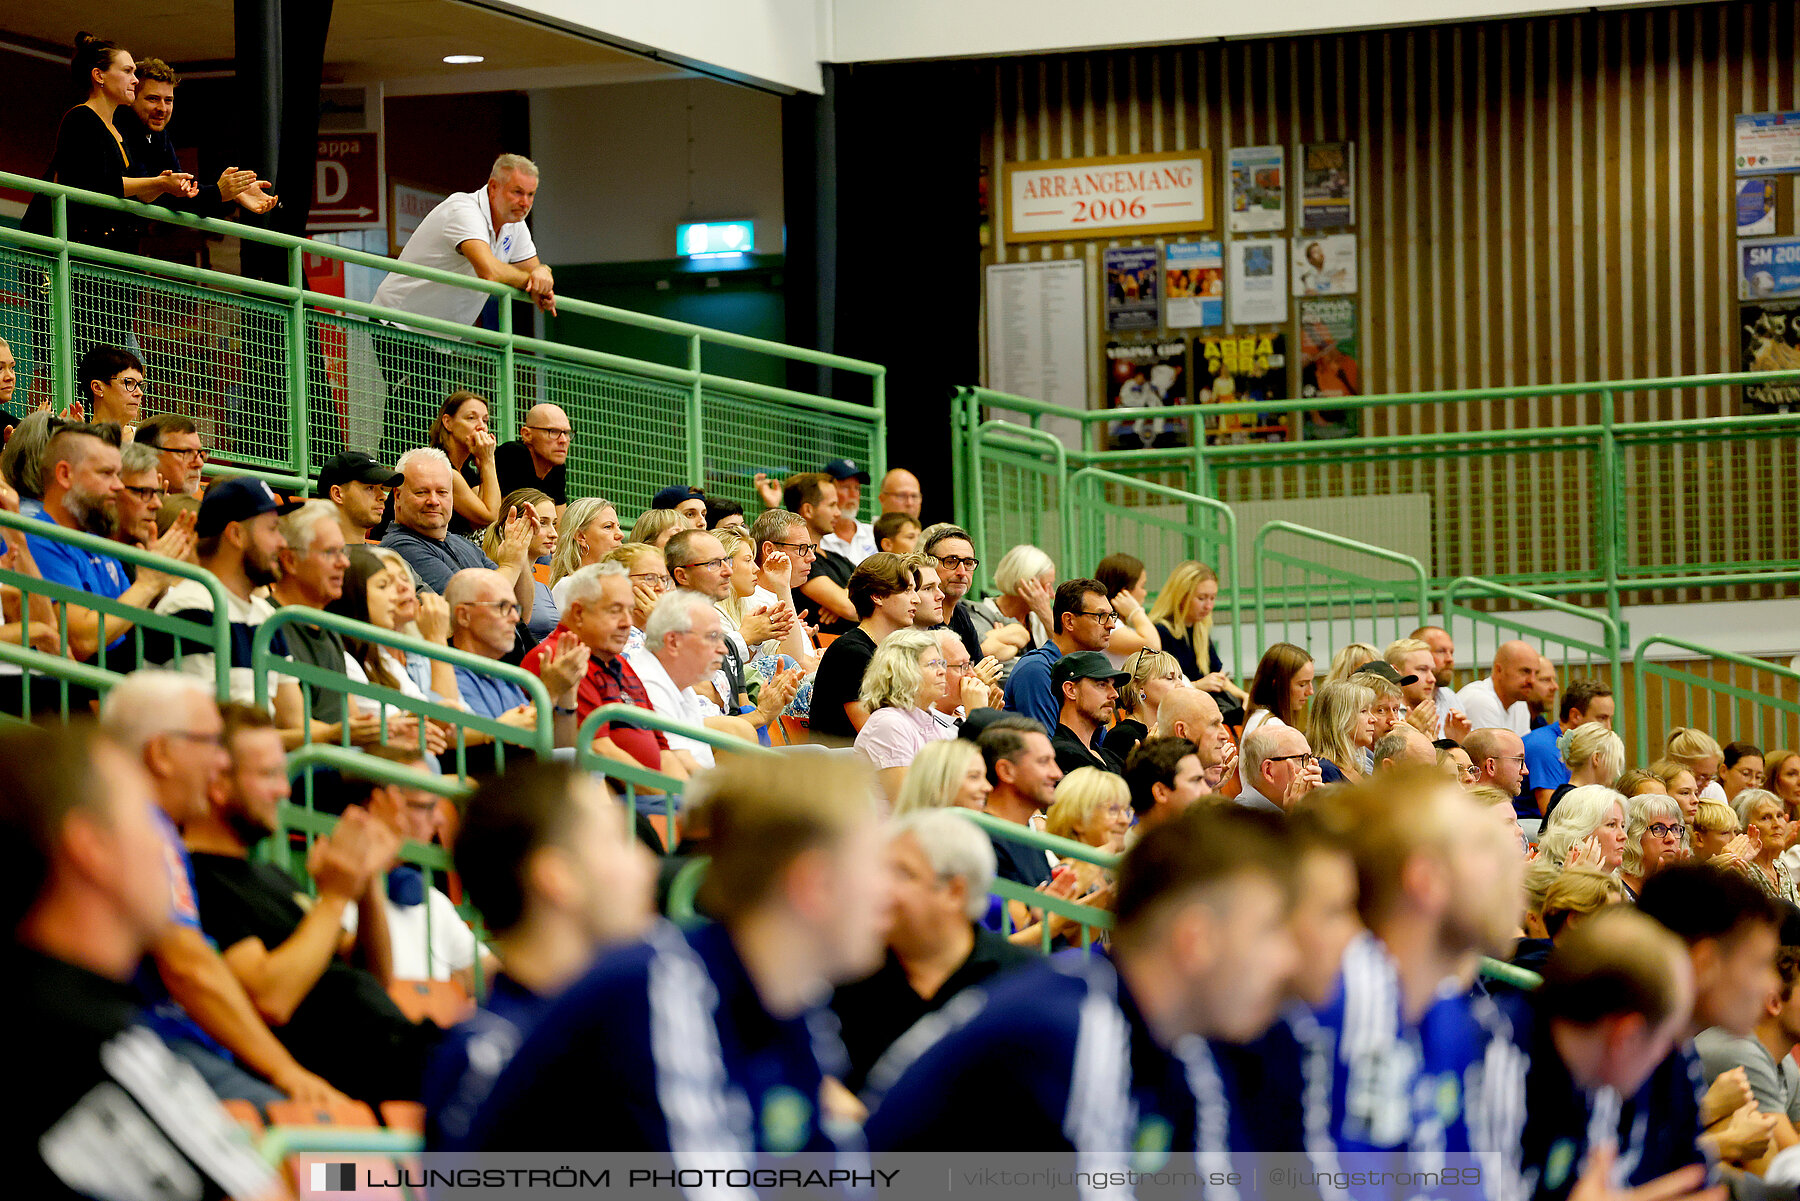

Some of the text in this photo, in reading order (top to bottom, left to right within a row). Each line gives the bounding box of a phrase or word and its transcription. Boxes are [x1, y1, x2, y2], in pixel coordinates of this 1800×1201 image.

[318, 141, 360, 157] appa
[316, 160, 348, 204] D
[1023, 165, 1193, 200] ARRANGEMANG
[1072, 196, 1147, 223] 2006
[1750, 248, 1773, 265] SM
